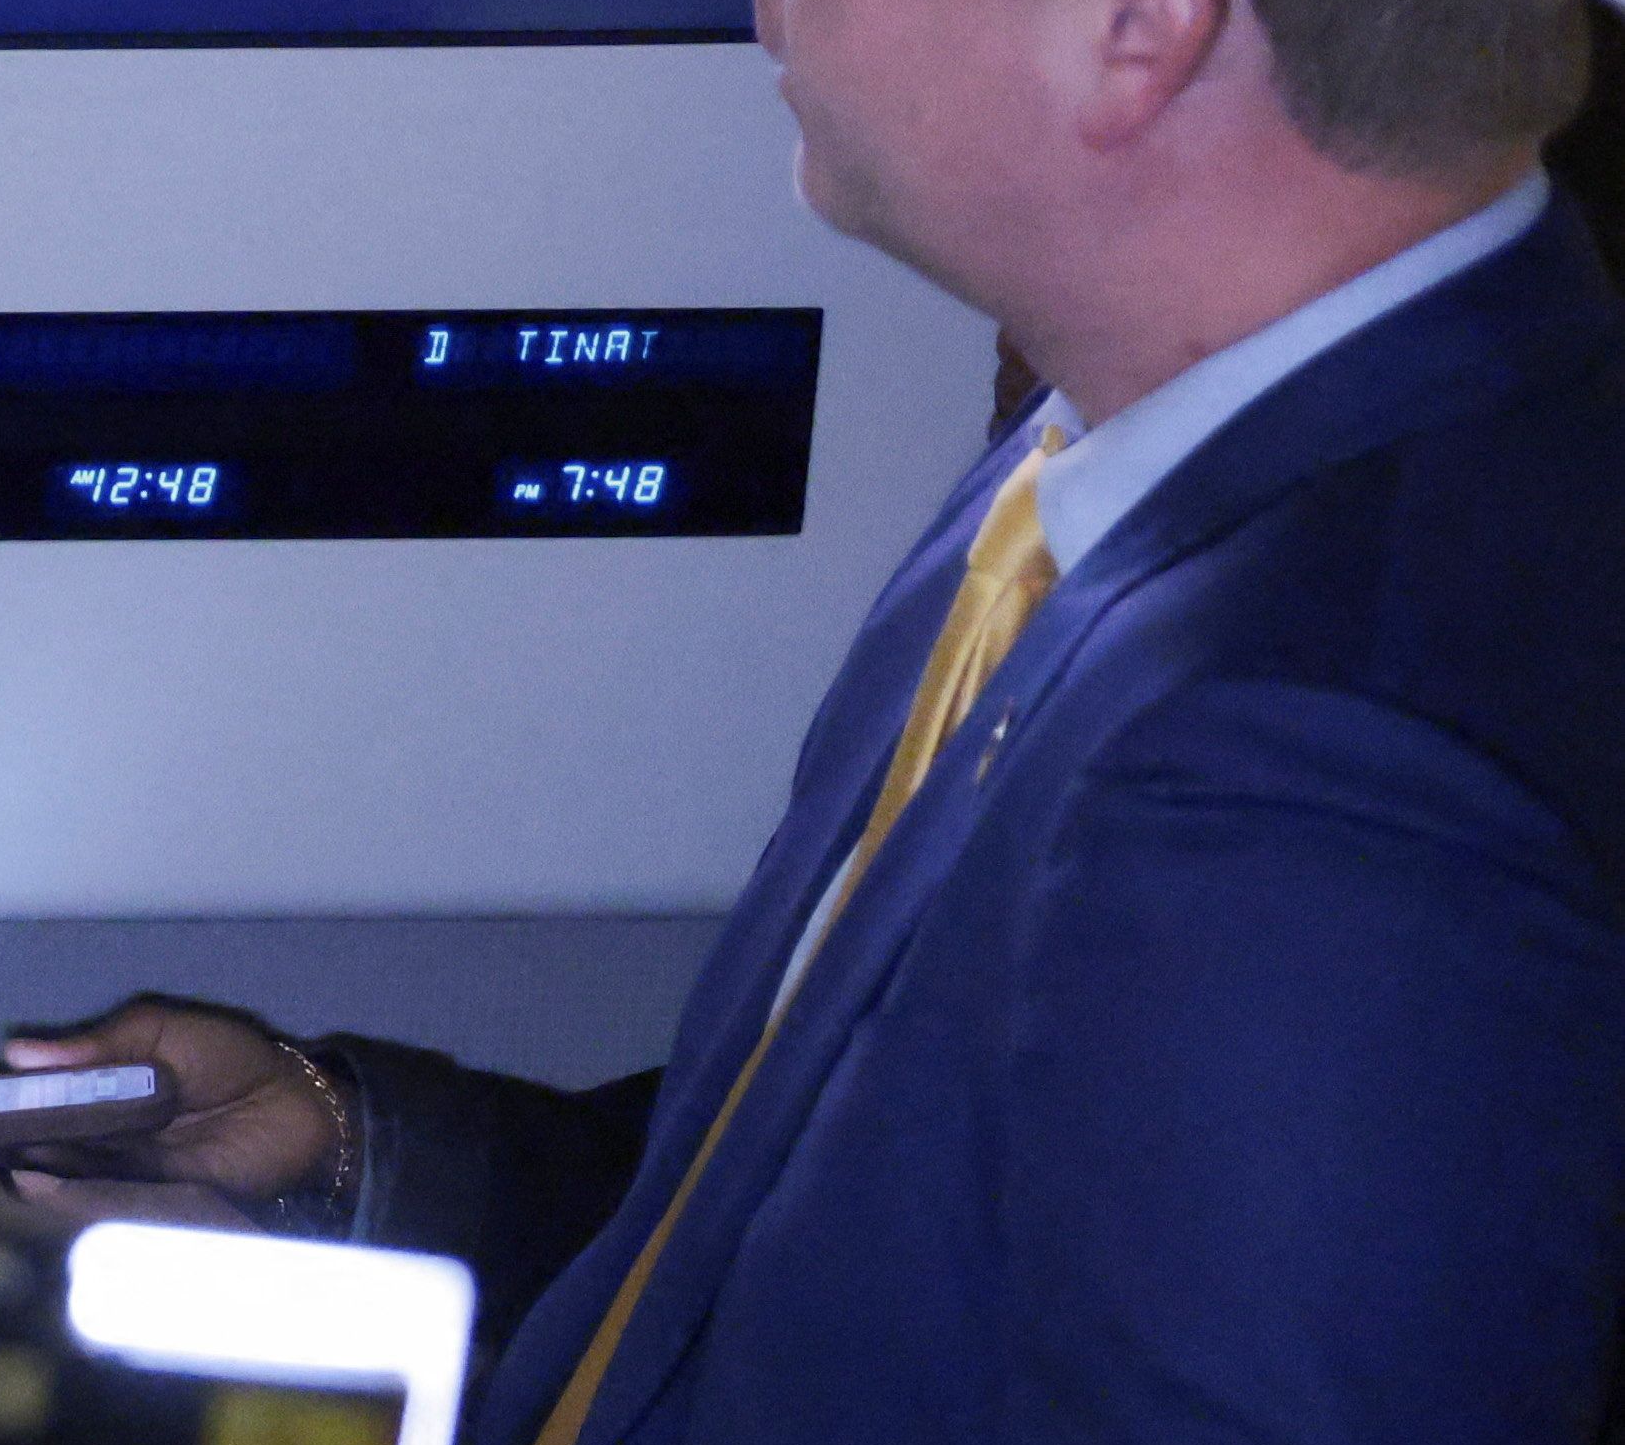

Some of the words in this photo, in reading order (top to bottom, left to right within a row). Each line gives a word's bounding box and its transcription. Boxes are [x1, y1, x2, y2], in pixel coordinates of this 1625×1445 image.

[70, 470, 97, 485] AM
[89, 467, 217, 505] 12:48
[513, 484, 541, 500] PM
[562, 465, 665, 504] 7:48
